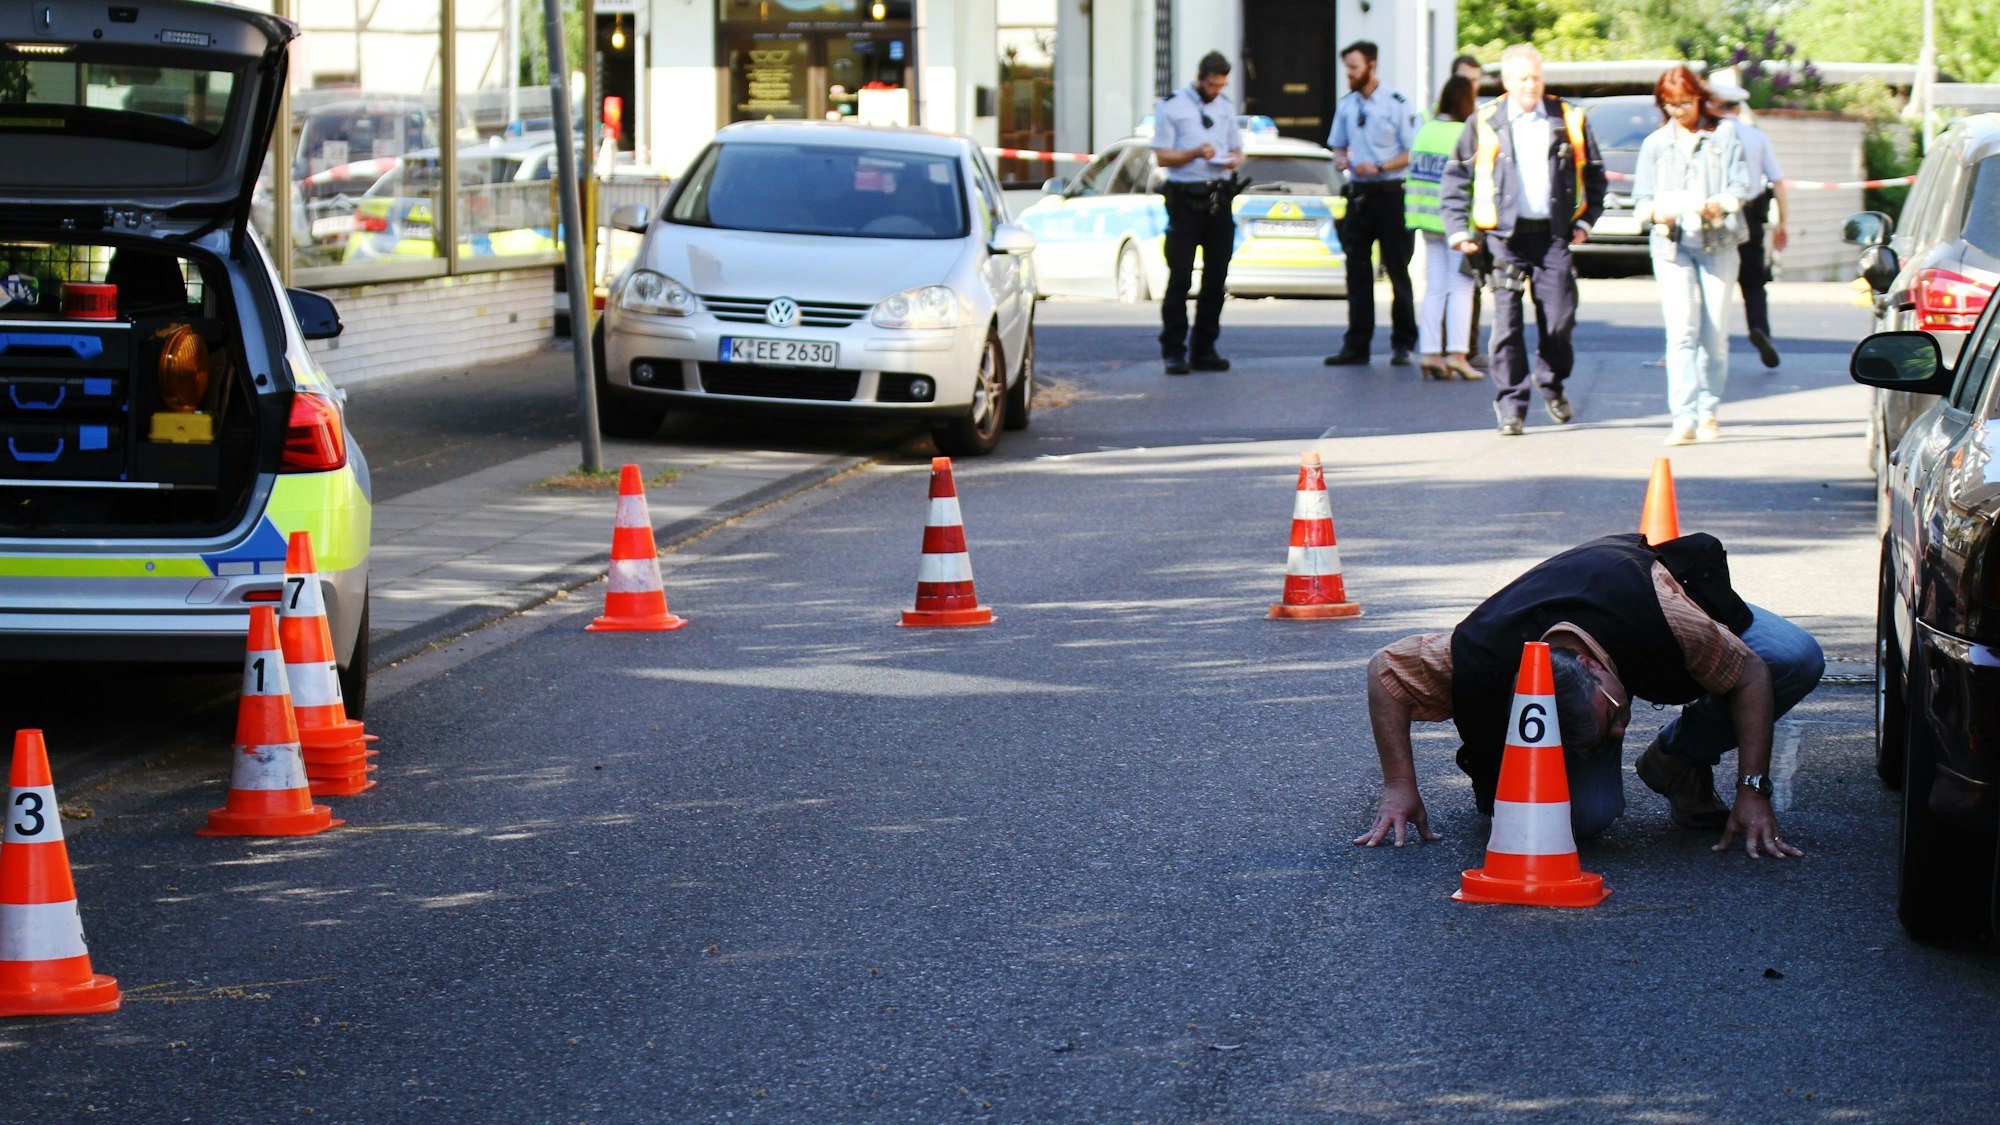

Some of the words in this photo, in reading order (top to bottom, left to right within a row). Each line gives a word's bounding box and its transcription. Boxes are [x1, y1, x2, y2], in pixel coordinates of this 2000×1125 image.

[1411, 153, 1446, 172] POLIZE
[732, 341, 743, 358] K
[757, 341, 780, 359] EE
[786, 343, 833, 363] 2630
[287, 577, 305, 609] 7
[252, 657, 265, 692] 1
[1519, 703, 1547, 743] 6
[14, 791, 45, 836] 3
